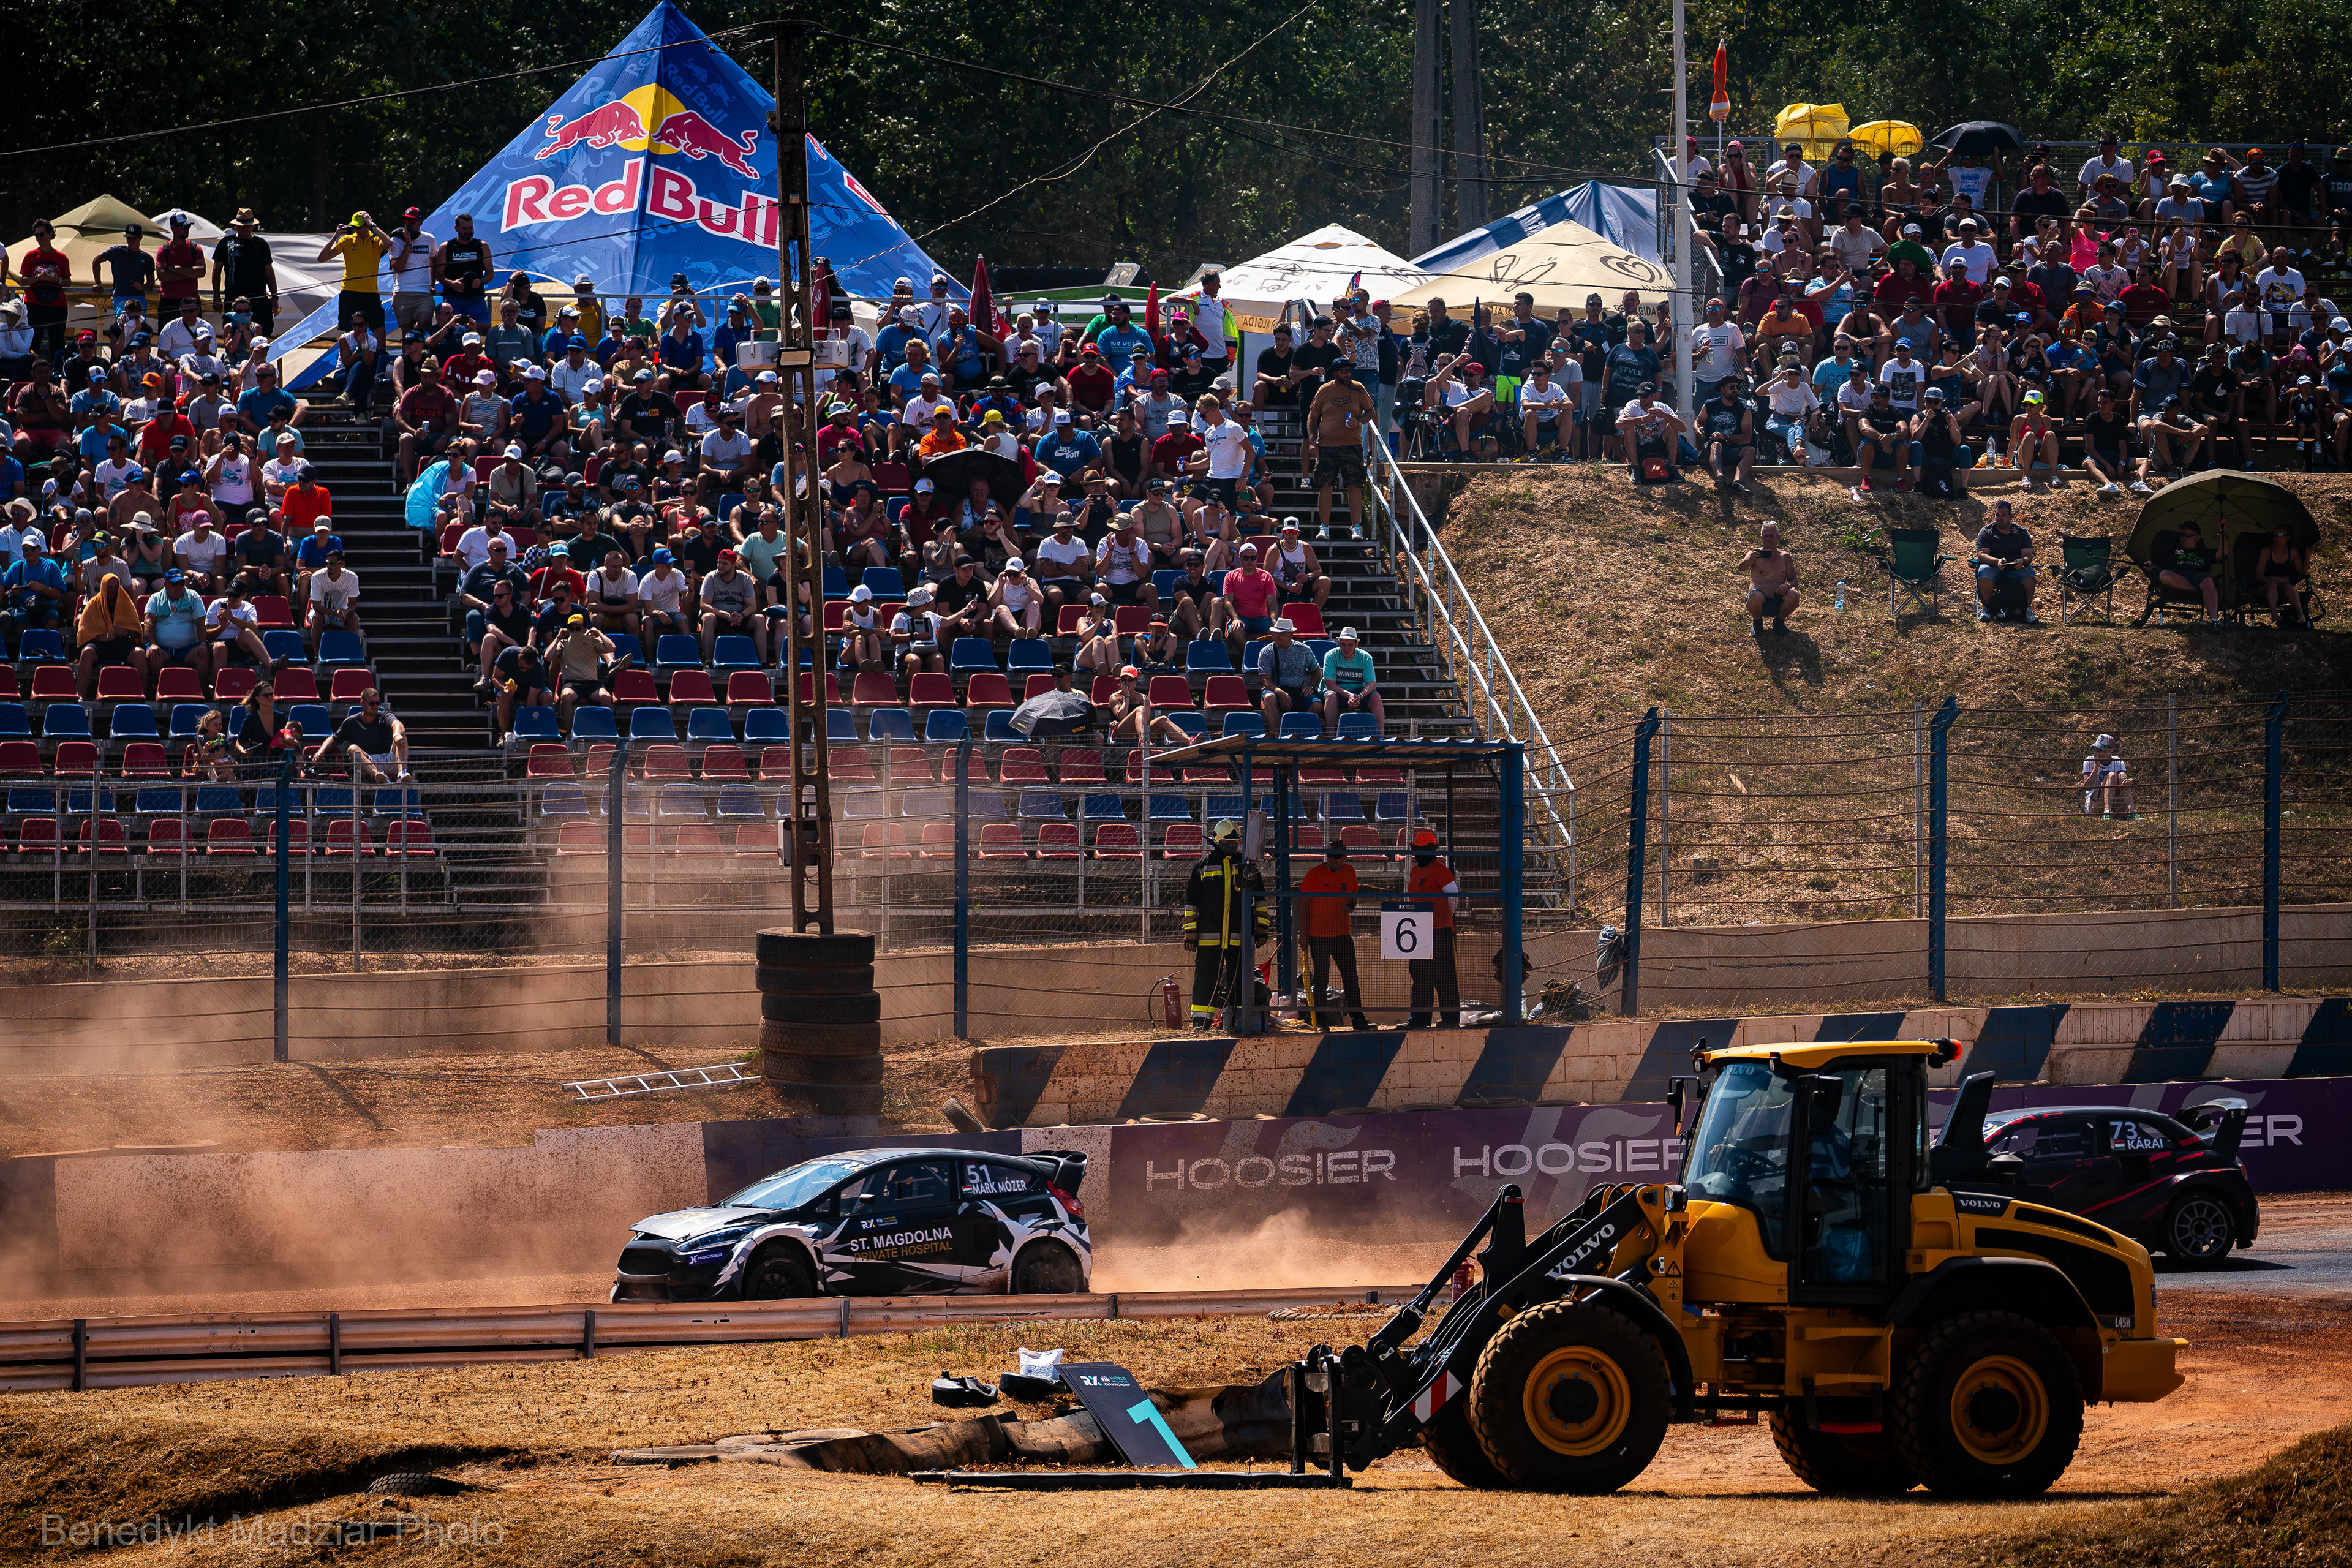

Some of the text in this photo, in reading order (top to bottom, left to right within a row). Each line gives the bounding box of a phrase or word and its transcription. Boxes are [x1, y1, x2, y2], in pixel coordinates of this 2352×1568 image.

[503, 159, 643, 232] Red
[647, 164, 779, 248] Bull
[1638, 306, 1657, 316] GIDA
[1619, 366, 1643, 377] STYLE
[1396, 917, 1417, 954] 6
[2109, 1121, 2138, 1140] 73
[2127, 1137, 2164, 1150] KÁRAI
[966, 1164, 991, 1183] 51
[1145, 1148, 1396, 1193] HOOSIER
[973, 1177, 1028, 1194] MÁRK MÓZER
[1959, 1199, 2002, 1209] VOLVO
[861, 1219, 876, 1229] RX
[850, 1226, 954, 1251] ST. MAGDOLNA
[854, 1241, 954, 1262] PRIVATE HOSPITAL
[1544, 1223, 1615, 1278] VOLVO
[1080, 1375, 1104, 1387] RX
[1126, 1398, 1198, 1469] 1
